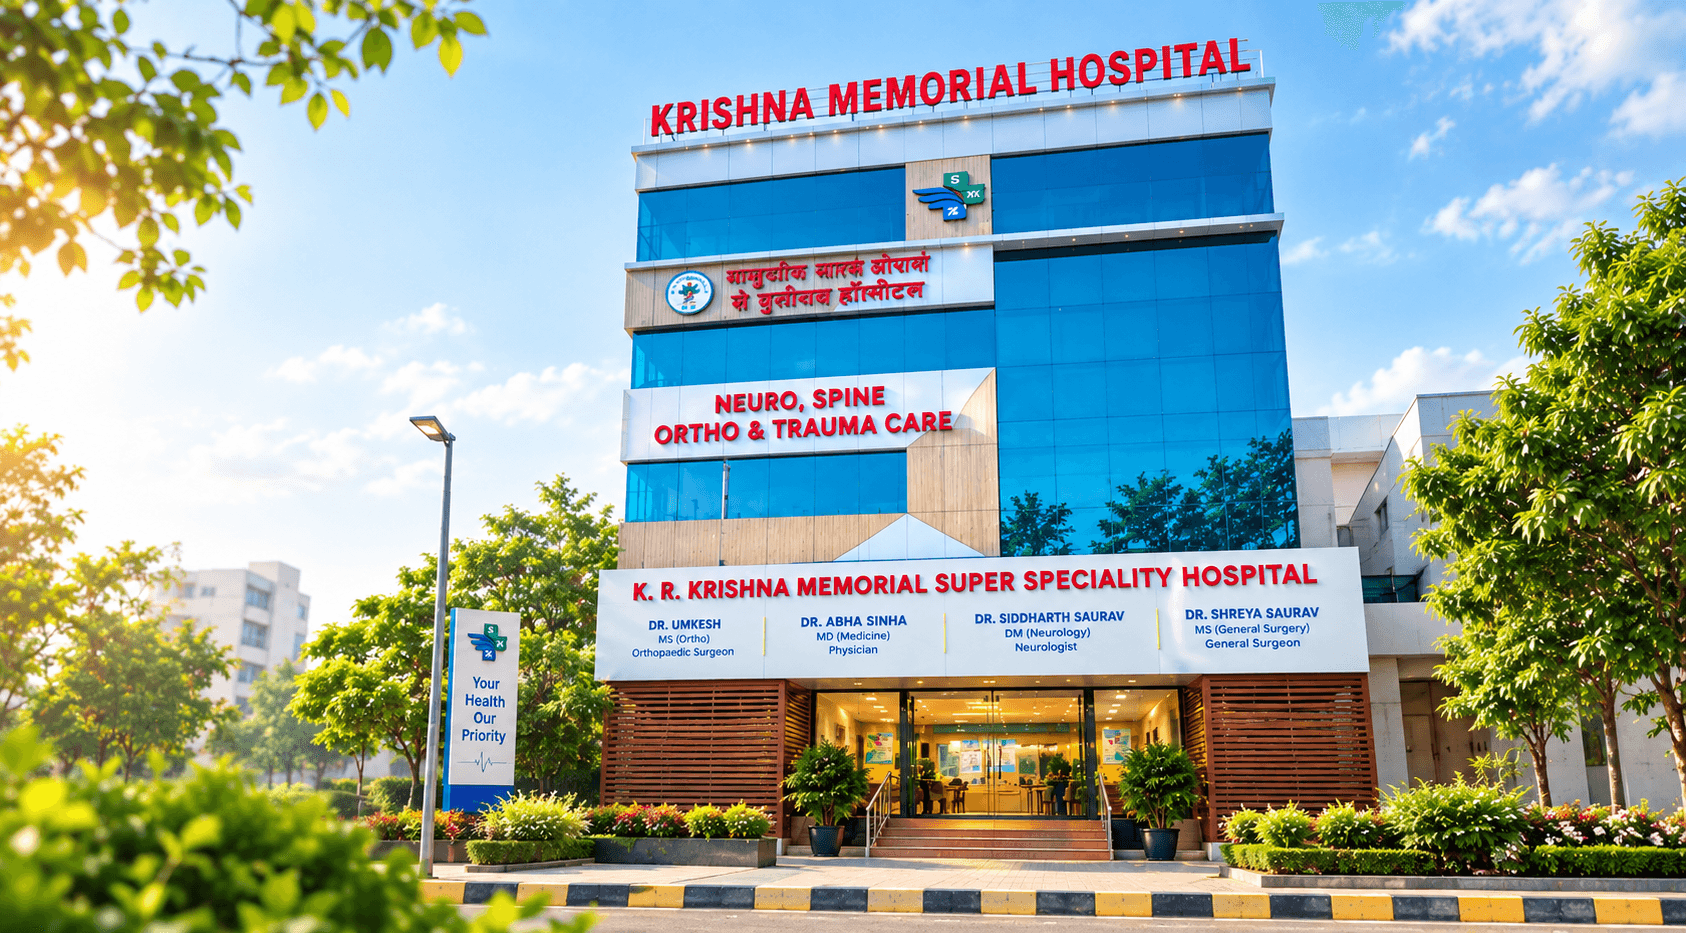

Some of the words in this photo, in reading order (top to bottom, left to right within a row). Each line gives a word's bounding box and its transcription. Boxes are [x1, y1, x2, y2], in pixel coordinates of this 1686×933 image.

[650, 87, 815, 137] KRISHNA
[828, 61, 1038, 116] MEMORIAL
[1049, 37, 1251, 91] HOSPITAL
[950, 174, 960, 185] S
[715, 390, 805, 414] NEURO,
[812, 385, 885, 410] SPINE
[654, 421, 740, 445] ORTHO
[747, 420, 765, 441] &
[772, 414, 878, 439] TRAUMA
[884, 410, 953, 434] CARE
[632, 582, 654, 602] K.
[660, 581, 681, 600] R.
[687, 577, 790, 600] KRISHNA
[796, 574, 928, 597] MEMORIAL
[934, 571, 1015, 594] SUPER
[1023, 566, 1173, 591] SPECIALITY
[1182, 563, 1318, 587] HOSPITAL
[974, 613, 997, 625] DR.
[999, 611, 1071, 624] SIDDHARTH
[1074, 610, 1125, 623] SAURAV
[1185, 609, 1209, 620] DR.
[1210, 607, 1263, 620] SHREYA
[1265, 606, 1320, 619] SAURAV
[648, 620, 669, 631] DR.
[671, 618, 721, 630] UMKESH
[800, 617, 823, 628] DR.
[825, 615, 863, 627] ABHA
[866, 614, 908, 627] SINHA
[816, 631, 834, 641] MD
[836, 630, 891, 642] (Medicine)
[1005, 628, 1023, 638] DM
[1026, 627, 1091, 640] (Neurology)
[1195, 625, 1212, 635] MS
[1214, 623, 1261, 636] (General
[1263, 622, 1310, 636] Surgery)
[658, 635, 674, 644] MS
[675, 634, 711, 645] (Ortho)
[1205, 638, 1250, 649] General
[1252, 638, 1301, 650] Surgeon
[631, 647, 692, 659] Orthopaedic
[693, 646, 735, 659] Surgeon
[829, 644, 879, 657] Physician
[1015, 641, 1078, 654] Neurologist
[472, 676, 501, 690] Your
[465, 693, 506, 708] Health
[473, 711, 497, 725] Our
[461, 728, 507, 746] Priority
